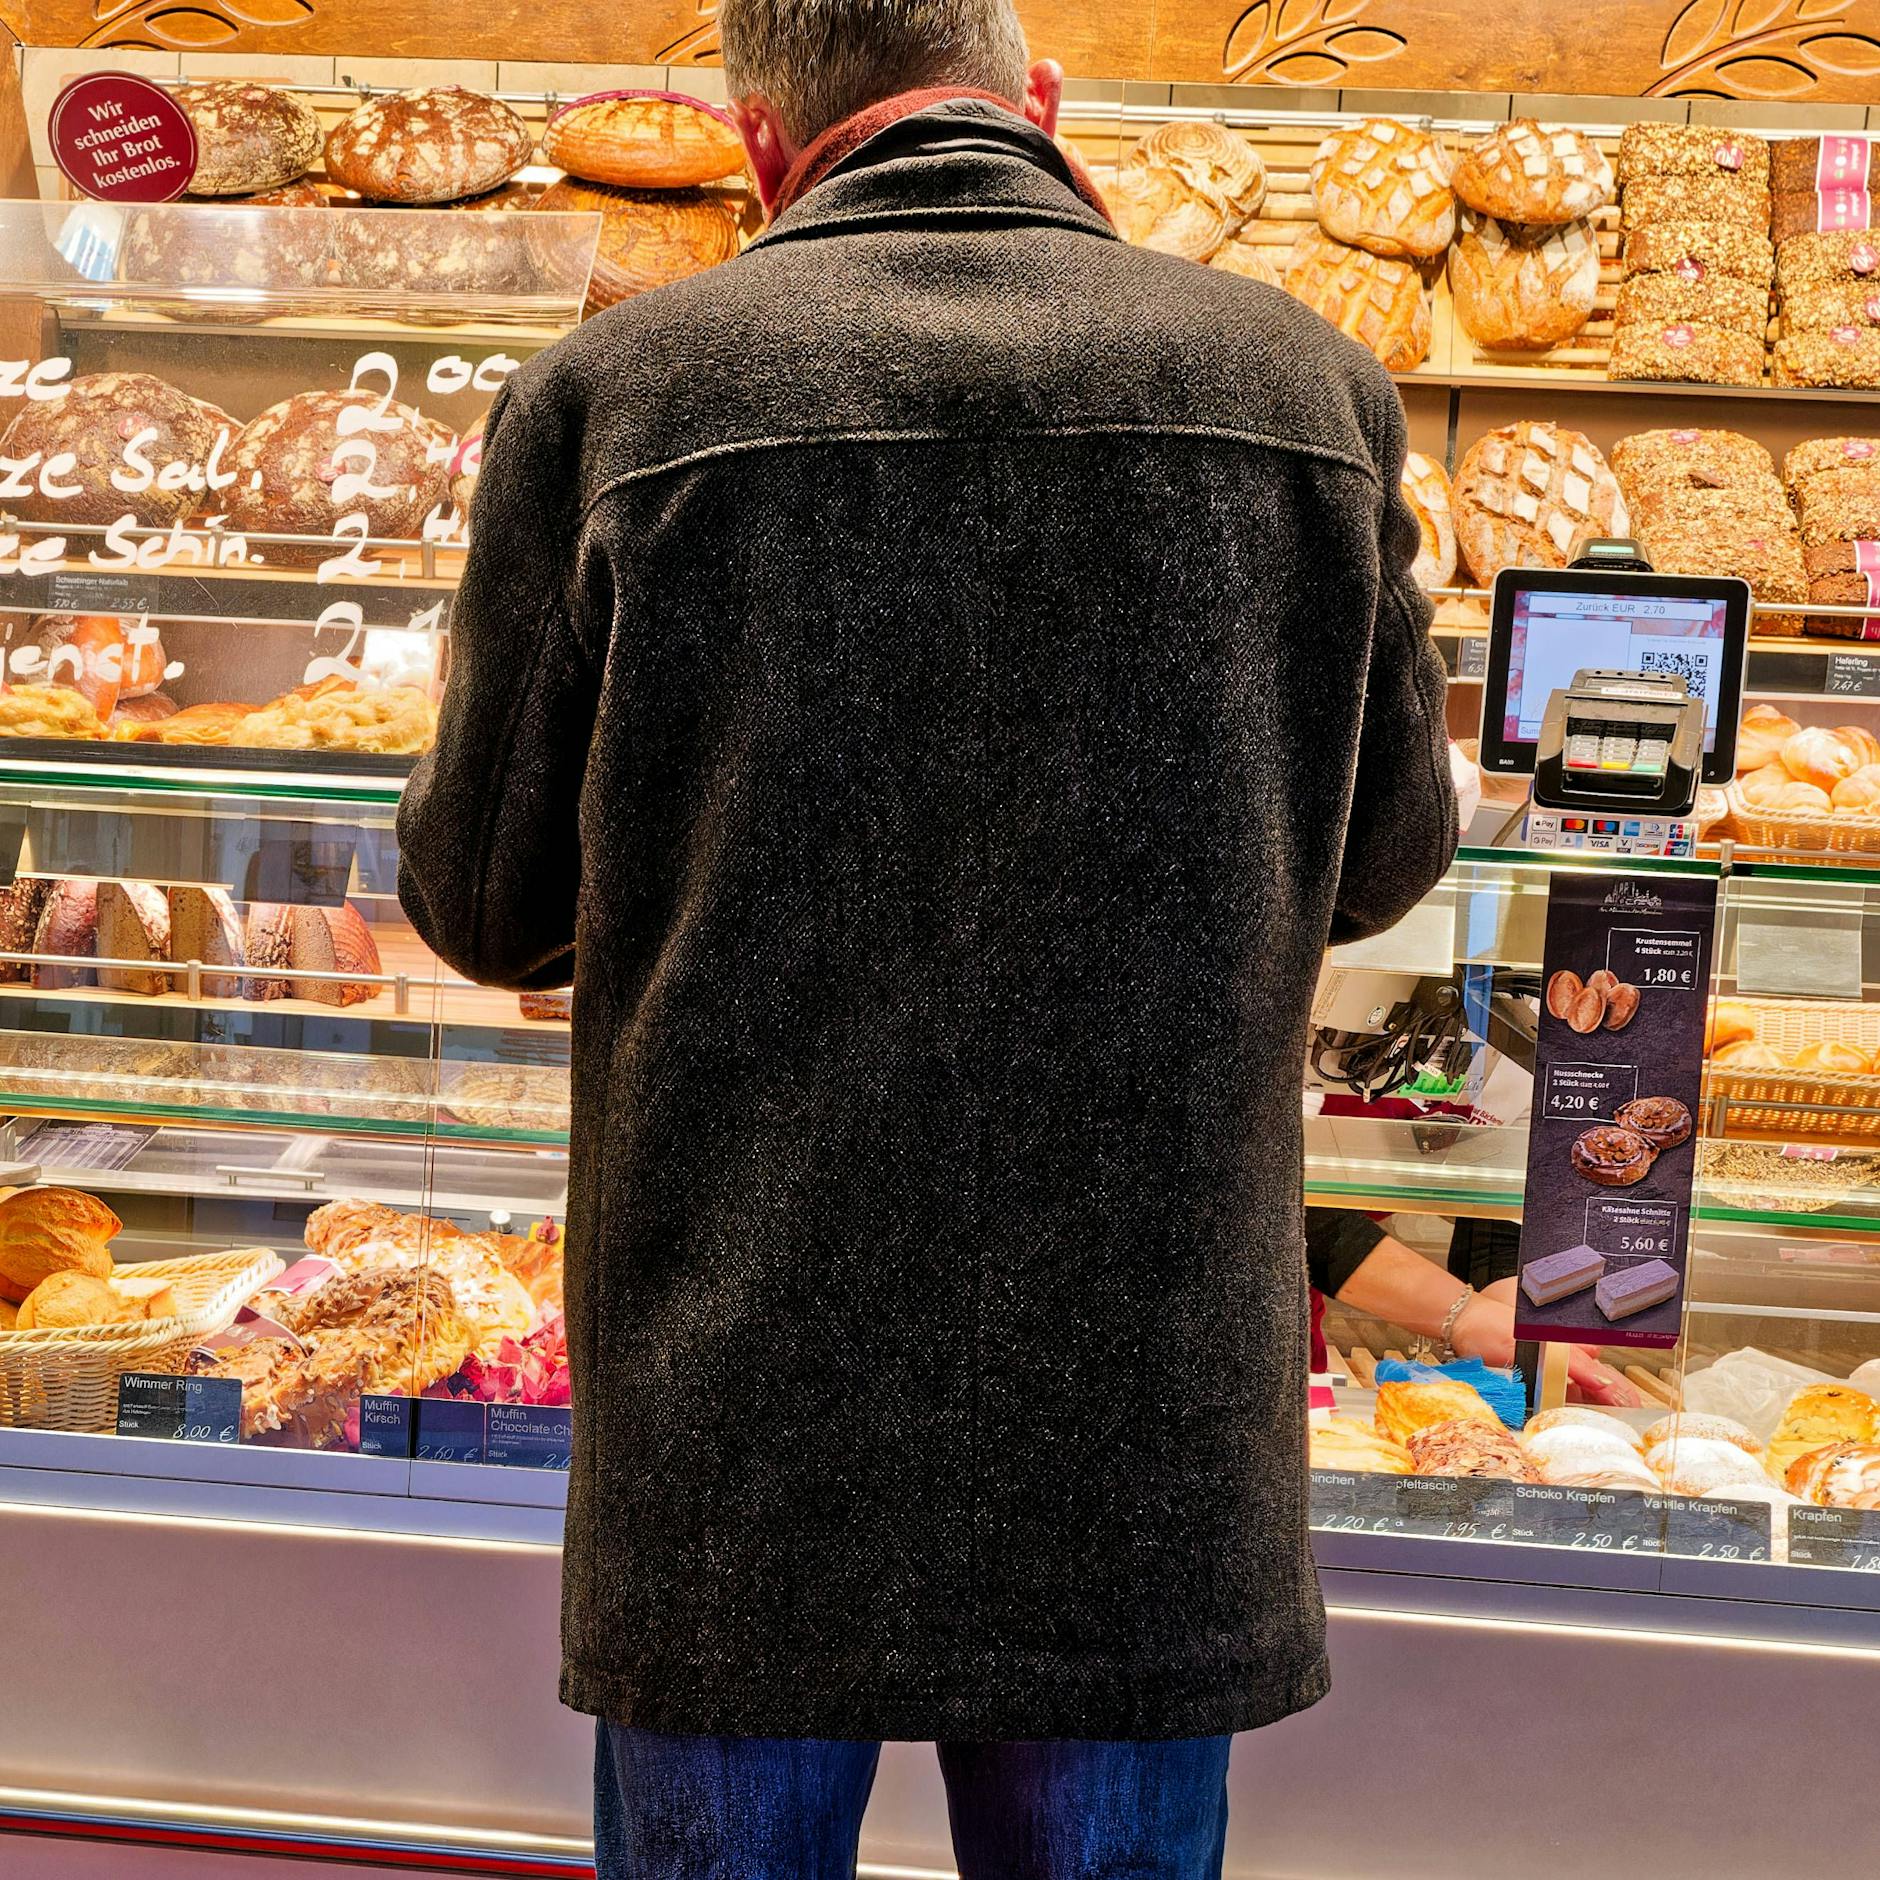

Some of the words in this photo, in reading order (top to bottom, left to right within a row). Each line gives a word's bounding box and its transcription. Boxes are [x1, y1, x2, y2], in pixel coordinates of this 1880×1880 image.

[88, 100, 123, 121] Wir
[74, 115, 162, 150] schneiden
[92, 149, 119, 167] Ihr
[121, 135, 163, 158] Brot
[92, 156, 181, 188] kostenlos.
[1576, 601, 1609, 613] Zurück
[1612, 603, 1635, 613] EUR
[1590, 840, 1609, 848] VISA
[1641, 947, 1661, 955] Stück
[1644, 968, 1677, 985] 1,80
[1681, 970, 1692, 983] €
[1558, 1079, 1579, 1087] Stück
[1551, 1094, 1584, 1110] 4,20
[1588, 1096, 1600, 1111] €
[1619, 1216, 1640, 1225] Stück
[1620, 1236, 1654, 1252] 5,60
[1658, 1238, 1669, 1252] €
[124, 1376, 173, 1390] Wimmer
[176, 1380, 202, 1393] Ring
[364, 1399, 400, 1412] Muffin
[364, 1412, 400, 1425] Kirsch
[491, 1407, 527, 1420] Muffin
[173, 1424, 211, 1441] 8,00
[219, 1425, 235, 1442] €
[491, 1420, 551, 1435] Chocolate
[1396, 1479, 1457, 1492] pfeltasche
[1516, 1487, 1563, 1500] Schoko
[1566, 1490, 1616, 1505] Krapfen
[1689, 1501, 1738, 1515] Krapfen
[1793, 1509, 1842, 1523] Krapfen
[1373, 1517, 1389, 1532] €
[1491, 1523, 1507, 1540] €
[1622, 1535, 1638, 1552] €
[1749, 1546, 1765, 1561] €
